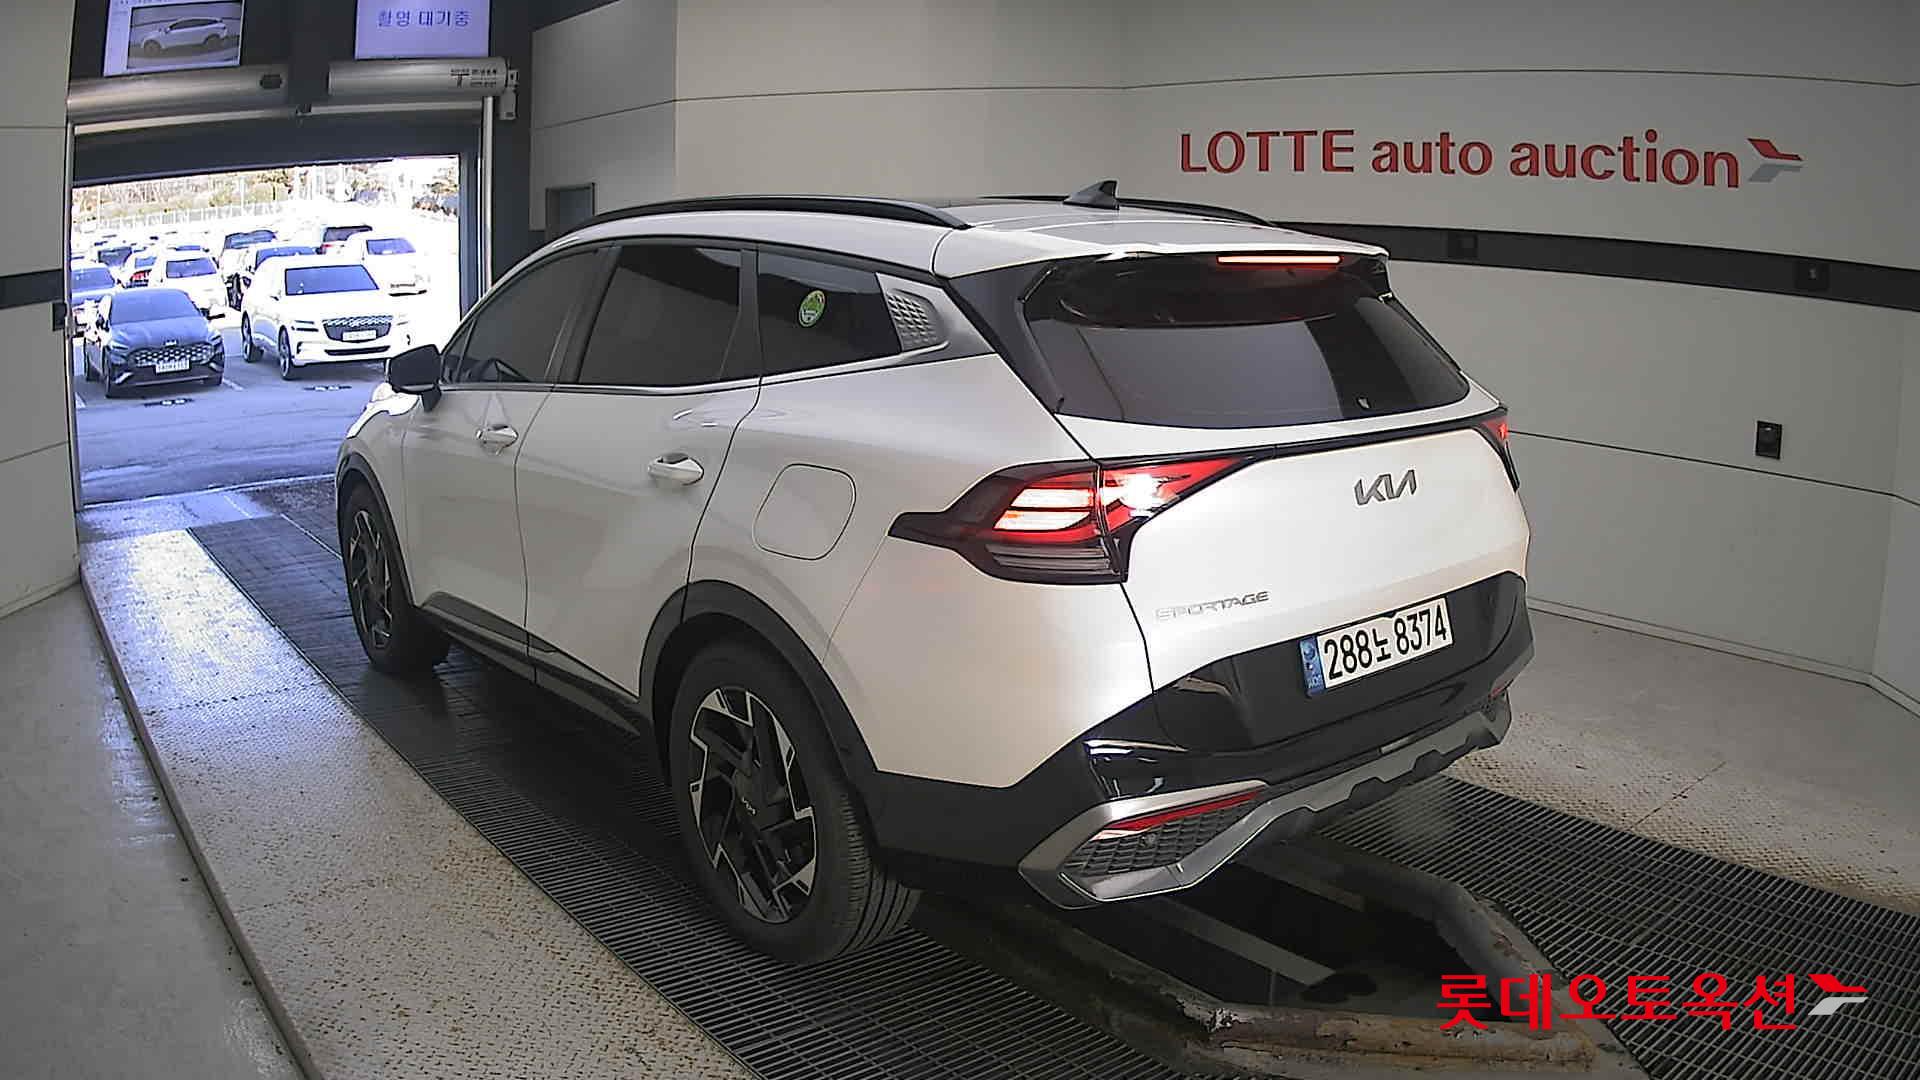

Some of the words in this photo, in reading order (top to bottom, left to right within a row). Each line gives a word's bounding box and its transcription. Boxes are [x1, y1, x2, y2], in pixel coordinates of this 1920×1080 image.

[418, 9, 470, 27] 대기중
[1180, 129, 1355, 173] LOTTE
[1371, 131, 1493, 176] auto
[1509, 129, 1741, 188] auction
[1353, 469, 1418, 506] KIA
[1323, 627, 1392, 681] 288노
[1394, 604, 1448, 656] 8374
